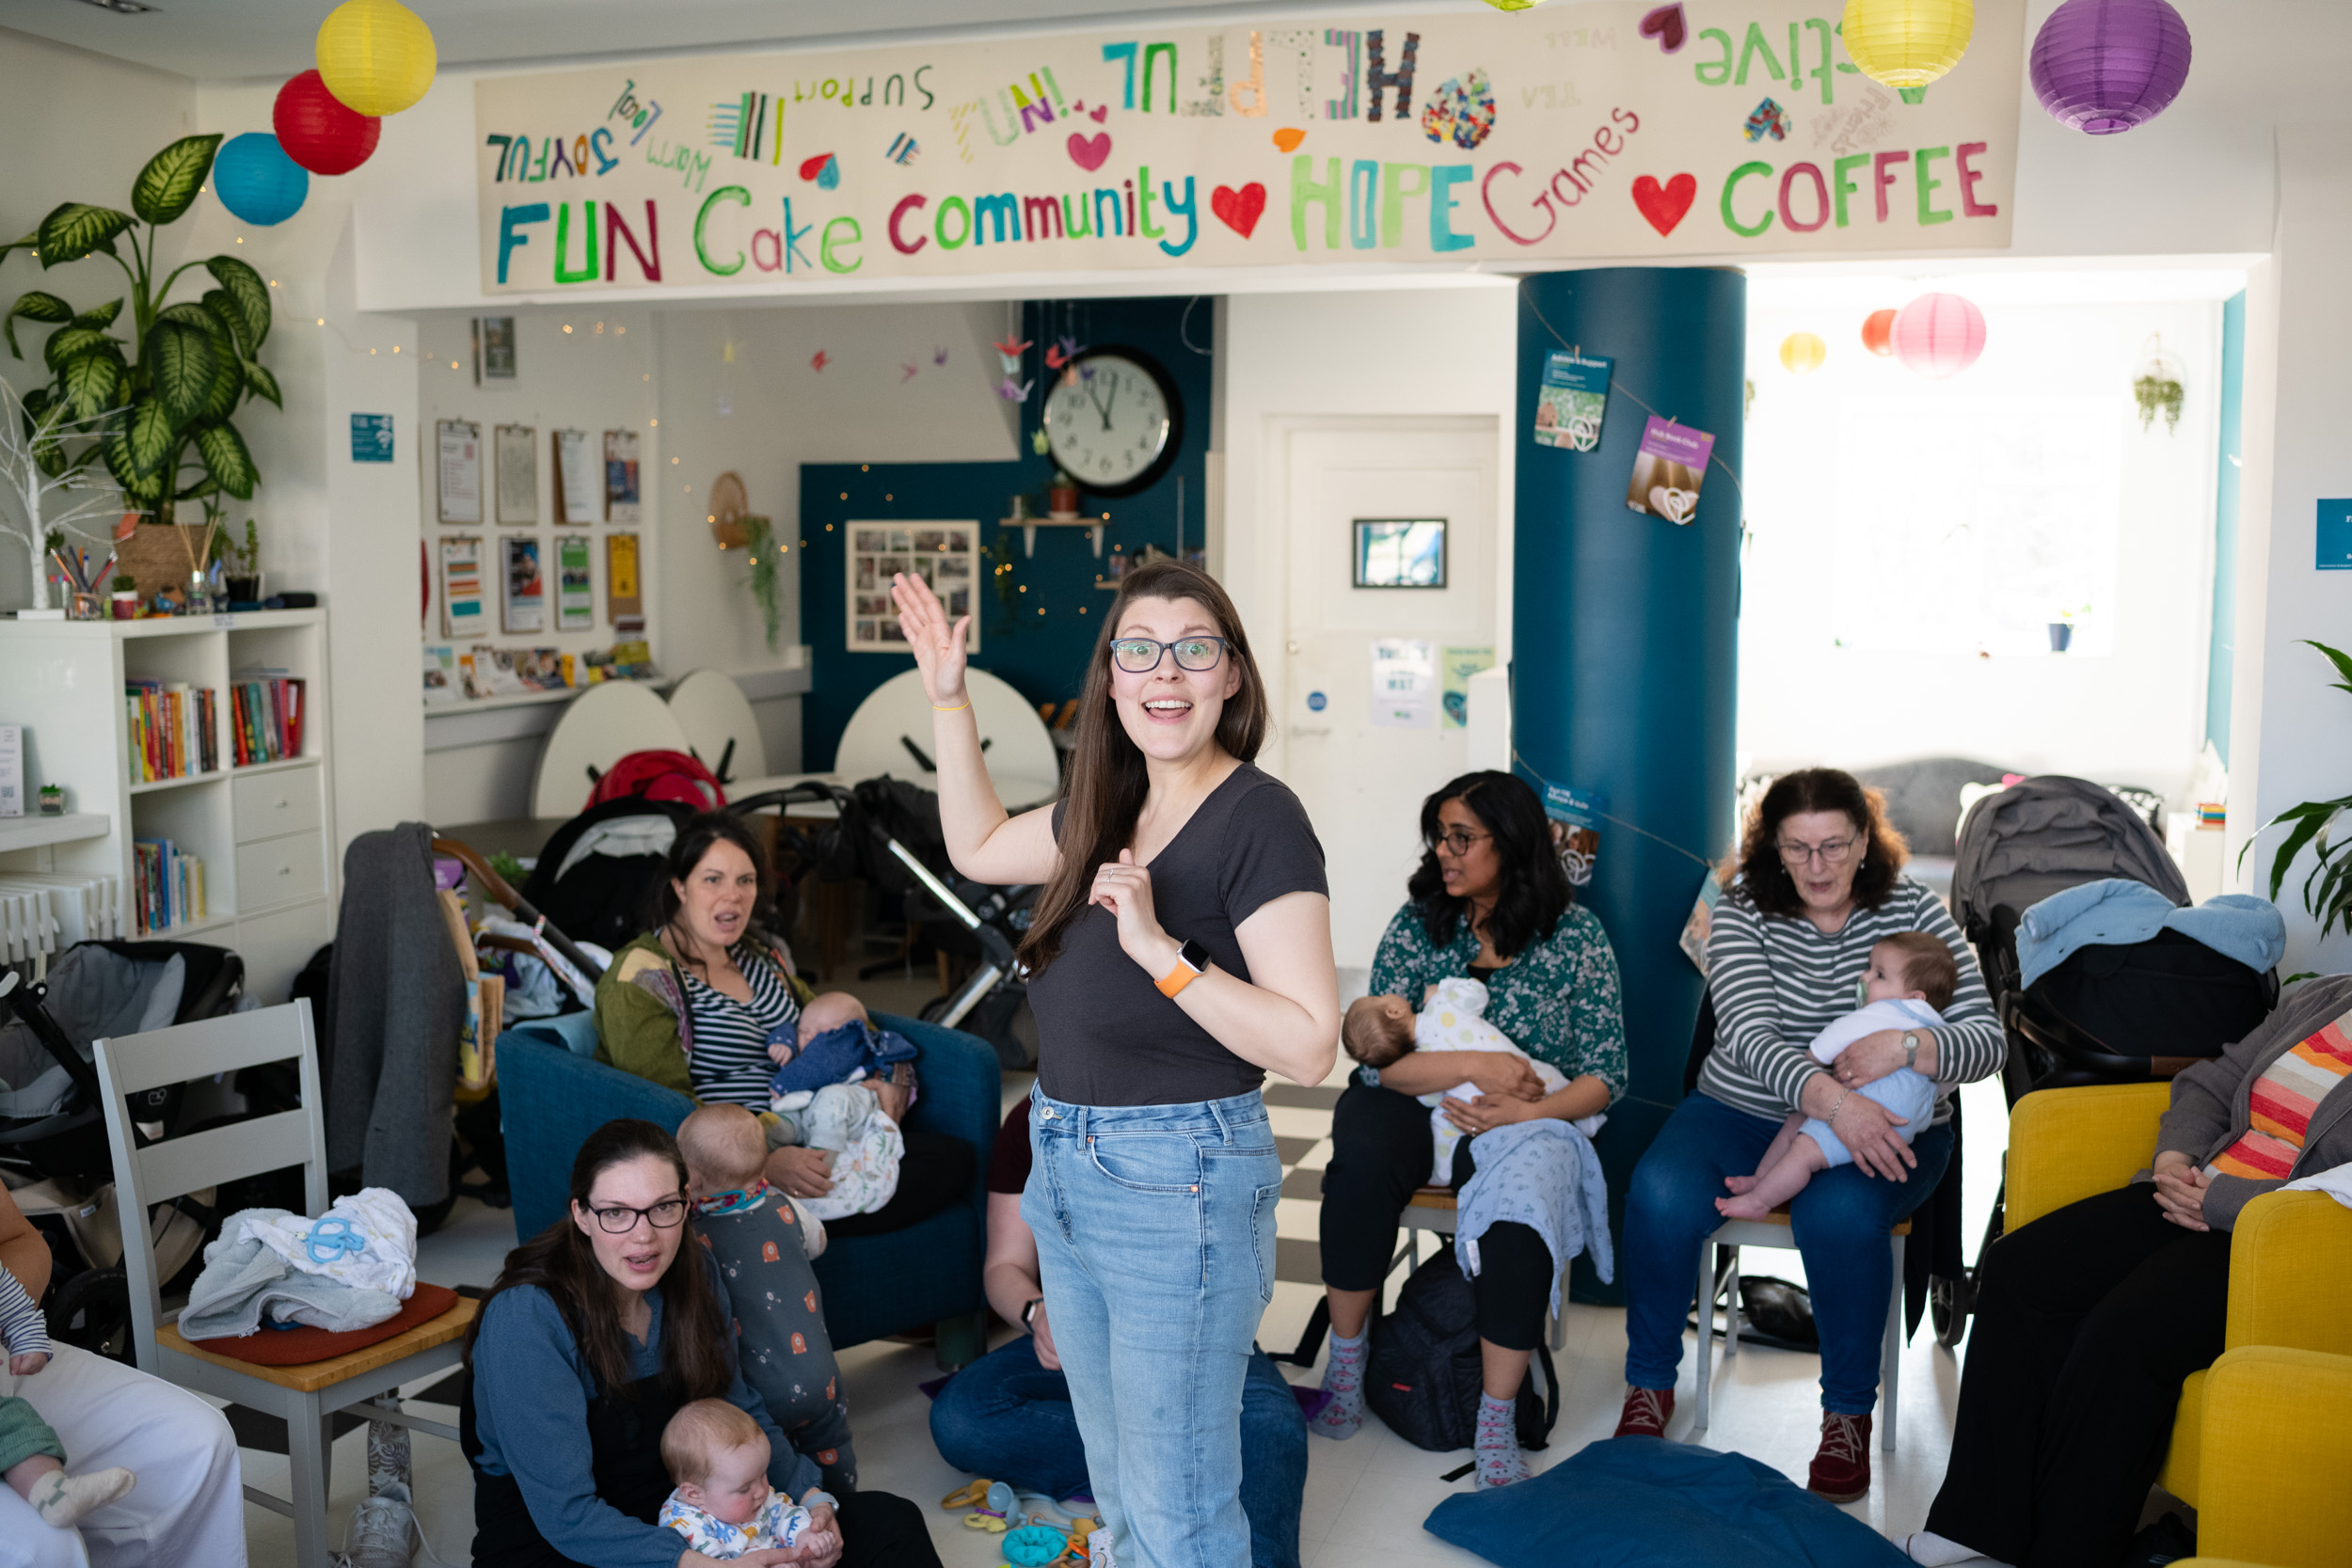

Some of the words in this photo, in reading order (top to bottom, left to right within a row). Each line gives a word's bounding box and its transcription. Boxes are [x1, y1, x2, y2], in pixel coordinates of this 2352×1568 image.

[1102, 28, 1420, 122] HELPFUL
[1694, 18, 1928, 104] tive
[486, 127, 619, 182] JOYFUL
[949, 66, 1069, 163] FUN!
[497, 198, 662, 284] FUN
[693, 185, 863, 277] Cake
[888, 166, 1198, 257] community
[1290, 154, 1476, 252] HOPE
[1482, 106, 1639, 246] Games
[1721, 142, 1998, 237] COFFEE
[645, 135, 712, 193] Warm
